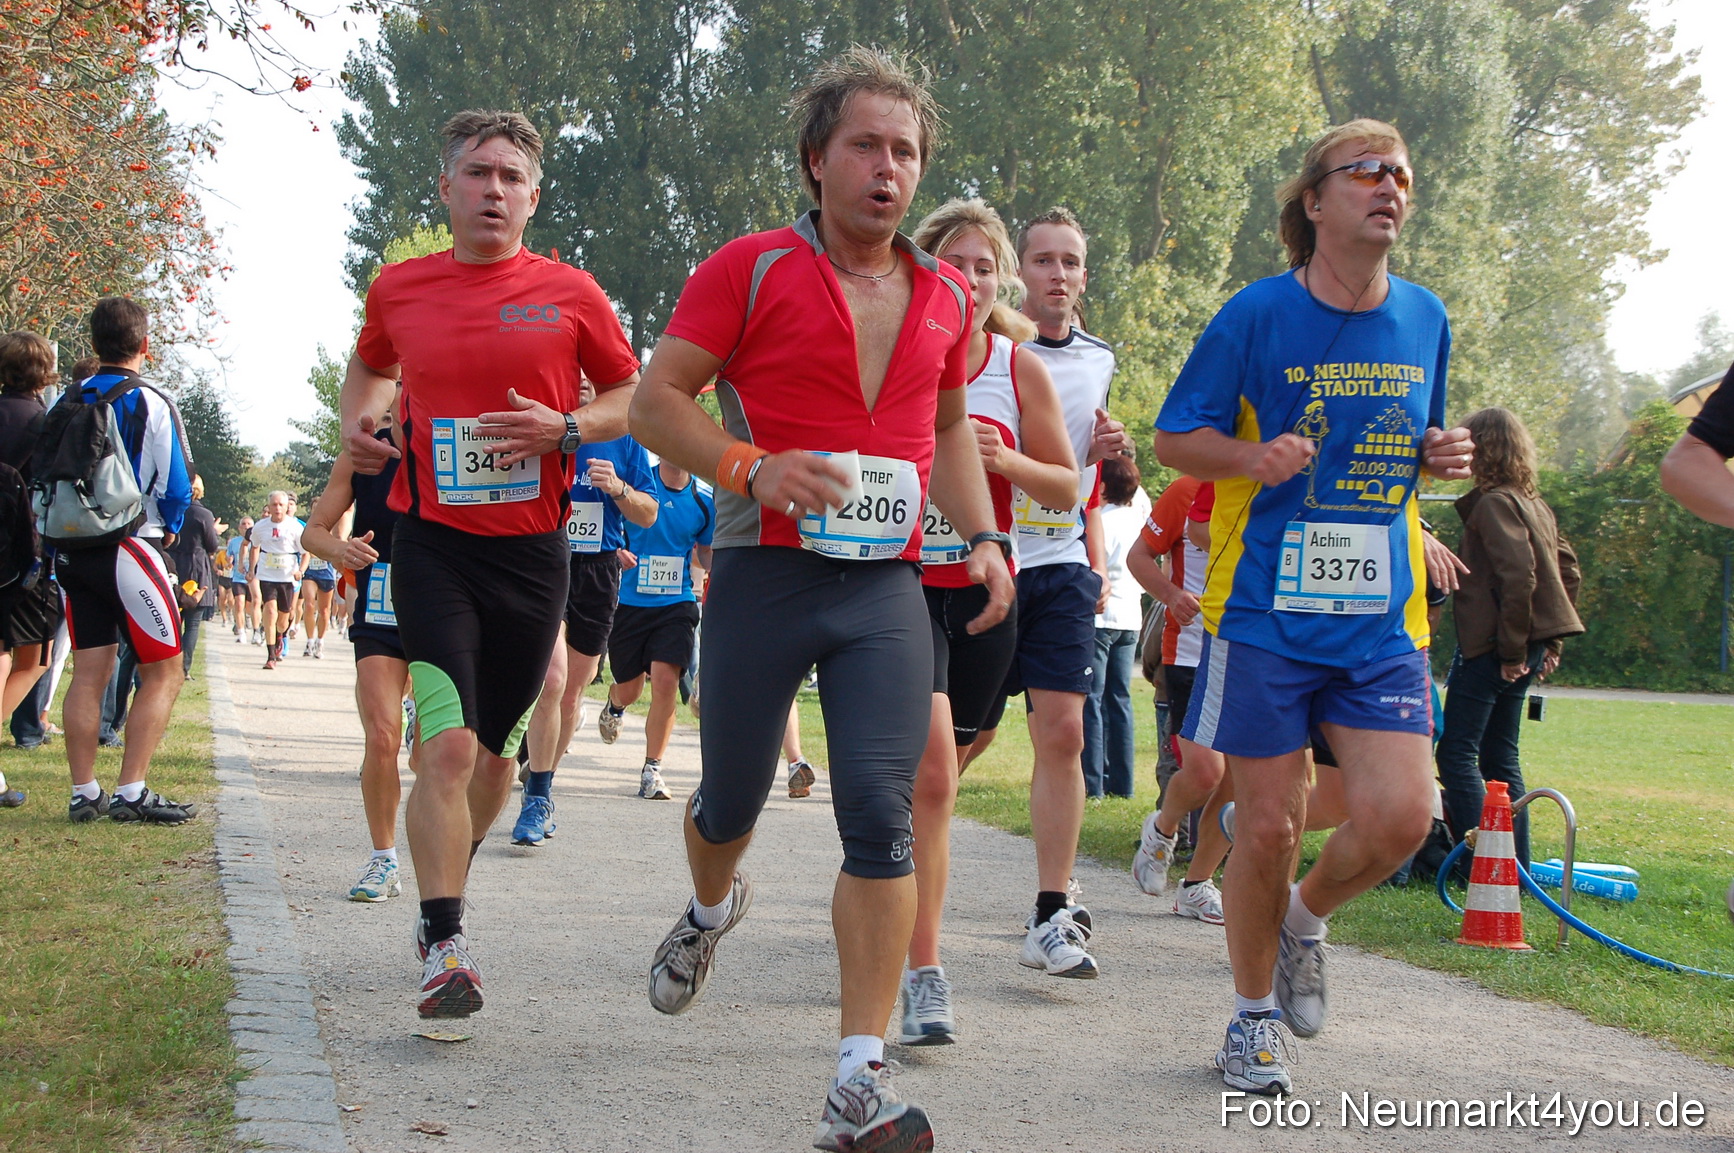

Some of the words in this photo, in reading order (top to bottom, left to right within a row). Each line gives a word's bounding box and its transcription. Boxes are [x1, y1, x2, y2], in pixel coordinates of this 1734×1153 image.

[499, 304, 560, 323] eco
[1284, 366, 1312, 384] 10.
[1313, 362, 1425, 384] NEUMARKTER
[1309, 379, 1411, 398] STADTLAUF
[440, 450, 447, 462] C
[501, 485, 539, 496] PFLEIDERER
[836, 494, 907, 525] 2806
[568, 521, 597, 536] 052
[1310, 531, 1351, 547] Achim
[652, 570, 678, 581] 3718
[1310, 558, 1377, 581] 3376
